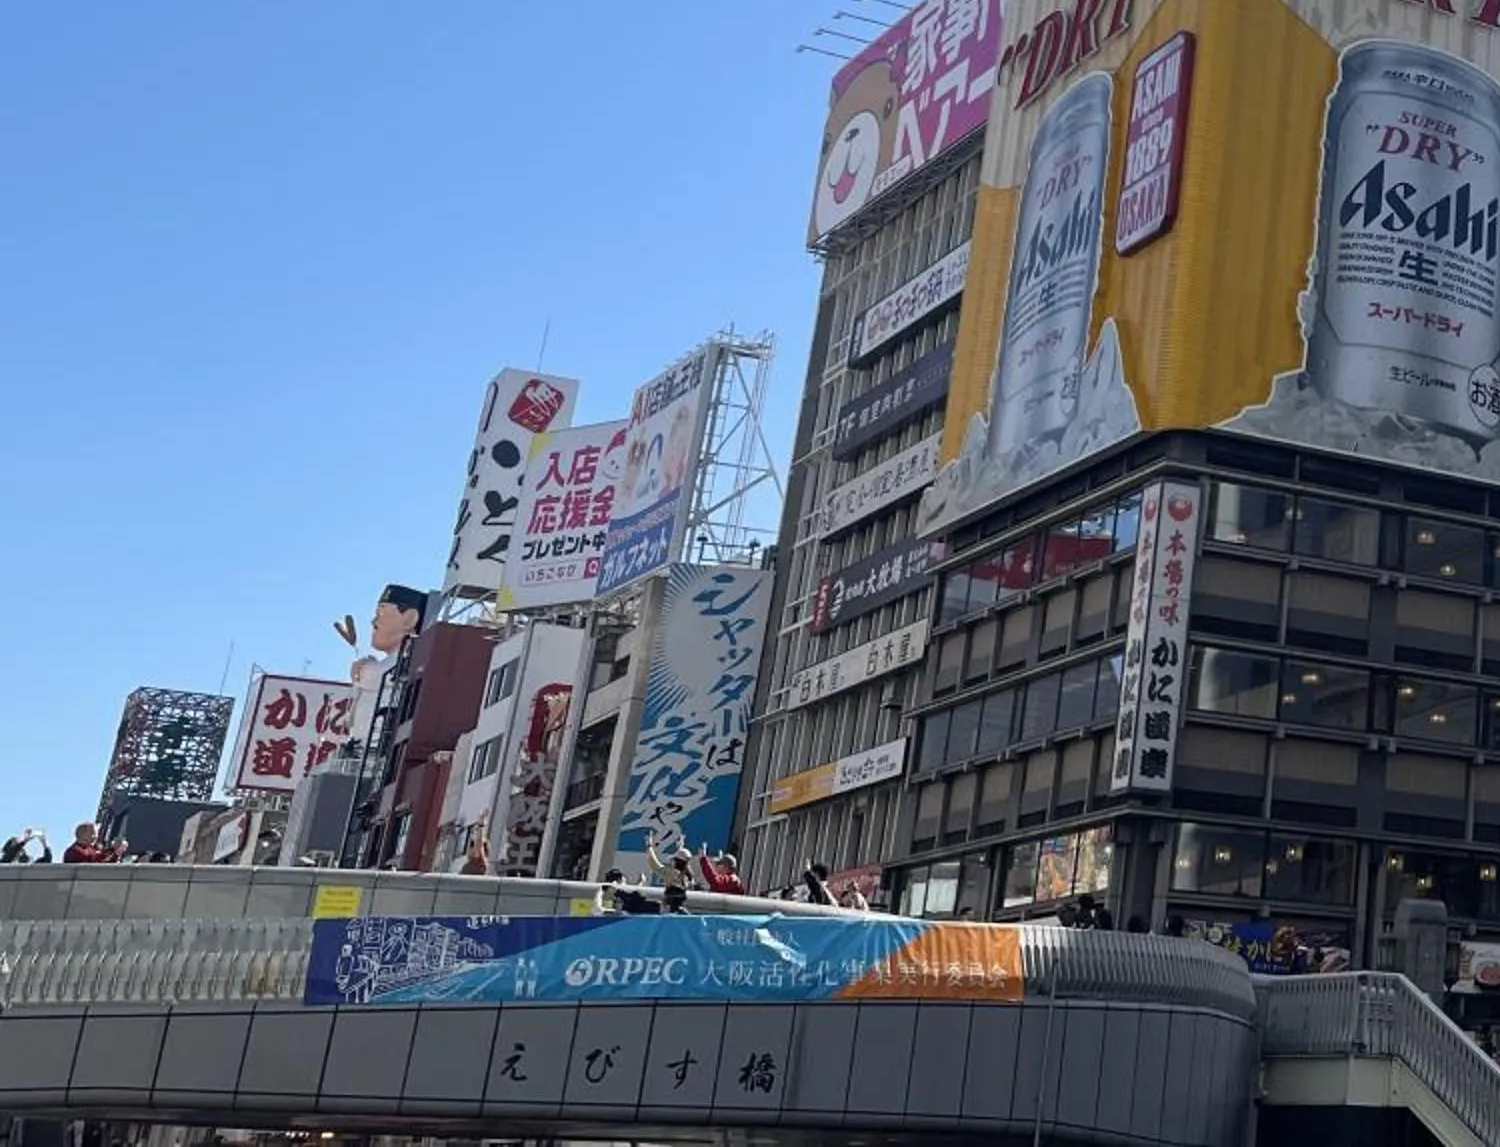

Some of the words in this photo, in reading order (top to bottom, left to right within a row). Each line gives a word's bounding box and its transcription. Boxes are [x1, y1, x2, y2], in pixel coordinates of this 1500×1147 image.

[1398, 110, 1457, 138] SUPER
[1124, 115, 1174, 190] 1889
[1338, 158, 1500, 262] Asahi
[1398, 250, 1438, 286] 生
[1367, 302, 1465, 338] スーパードライ
[535, 444, 606, 492] 入店
[525, 484, 616, 535] 応援金
[520, 532, 605, 561] プレゼント中
[1138, 636, 1180, 780] かに道楽
[564, 953, 690, 987] ORPEC
[500, 1042, 779, 1095] えびす橋
